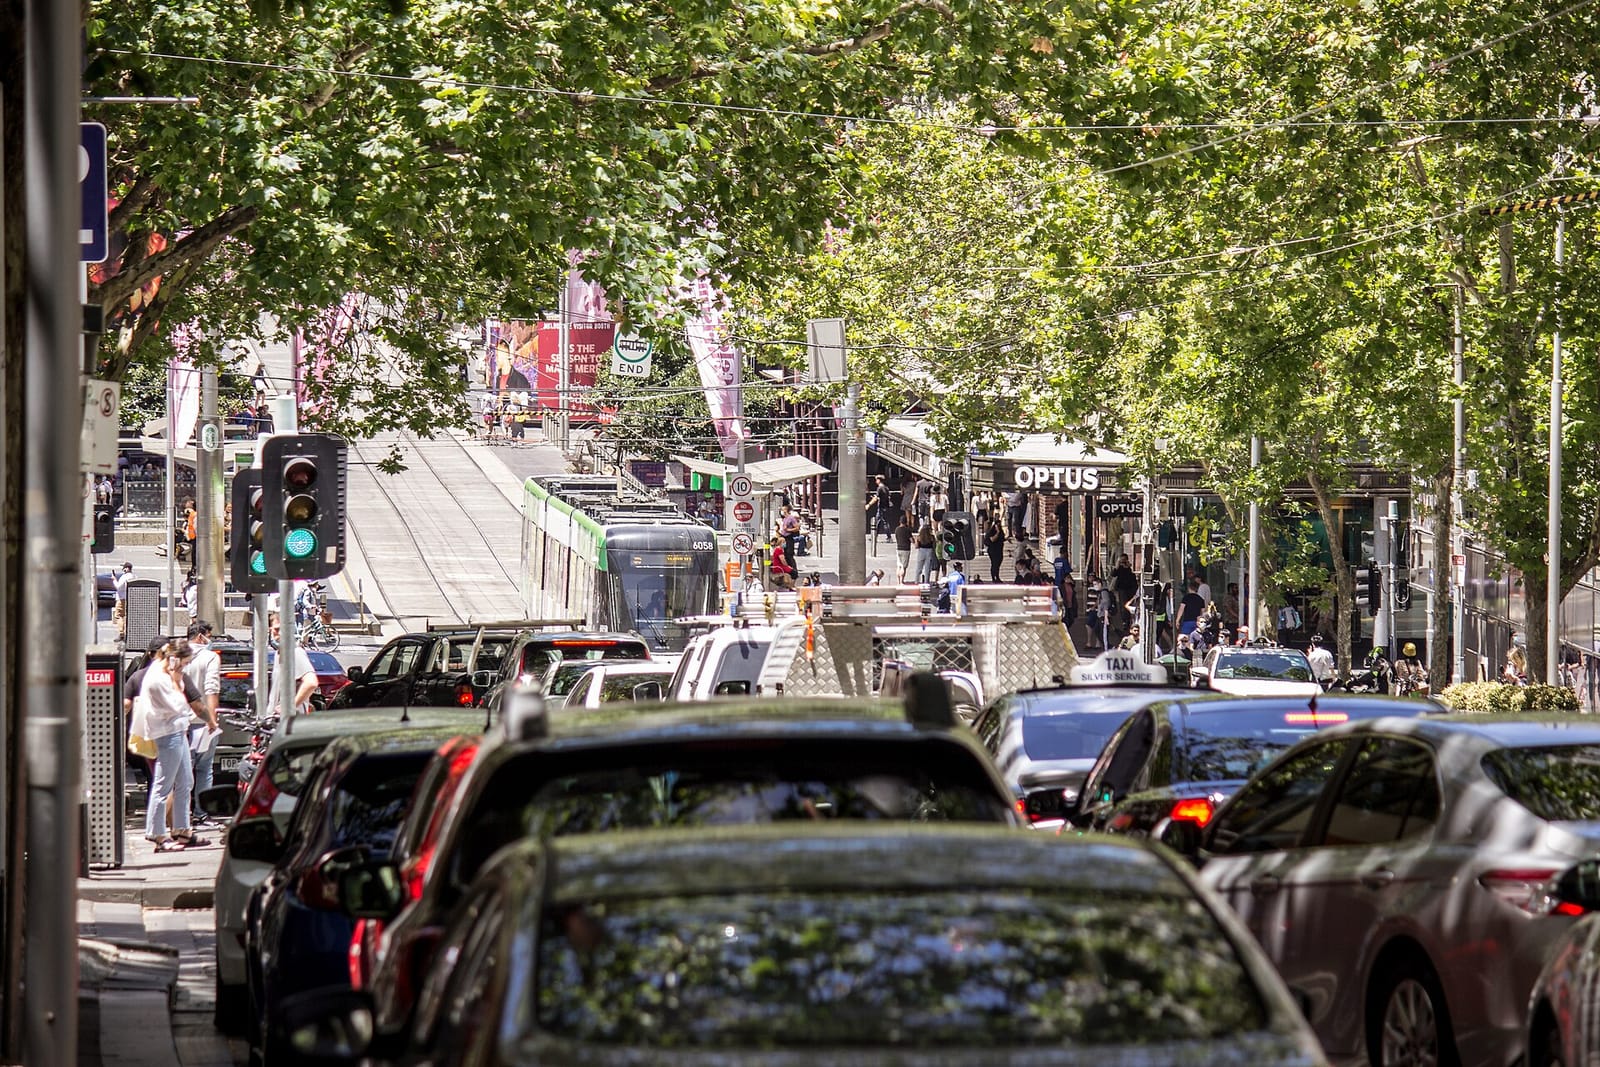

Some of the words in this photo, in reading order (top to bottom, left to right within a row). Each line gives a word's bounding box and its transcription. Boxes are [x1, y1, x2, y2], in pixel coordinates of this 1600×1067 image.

[577, 344, 595, 353] THE
[619, 363, 644, 374] END
[1014, 465, 1098, 490] OPTUS
[736, 481, 747, 492] 10
[1101, 503, 1142, 513] OPTUS
[693, 542, 713, 550] 6058
[1105, 657, 1134, 671] TAXI
[1081, 672, 1112, 681] SILVER
[1114, 673, 1152, 681] SERVICE
